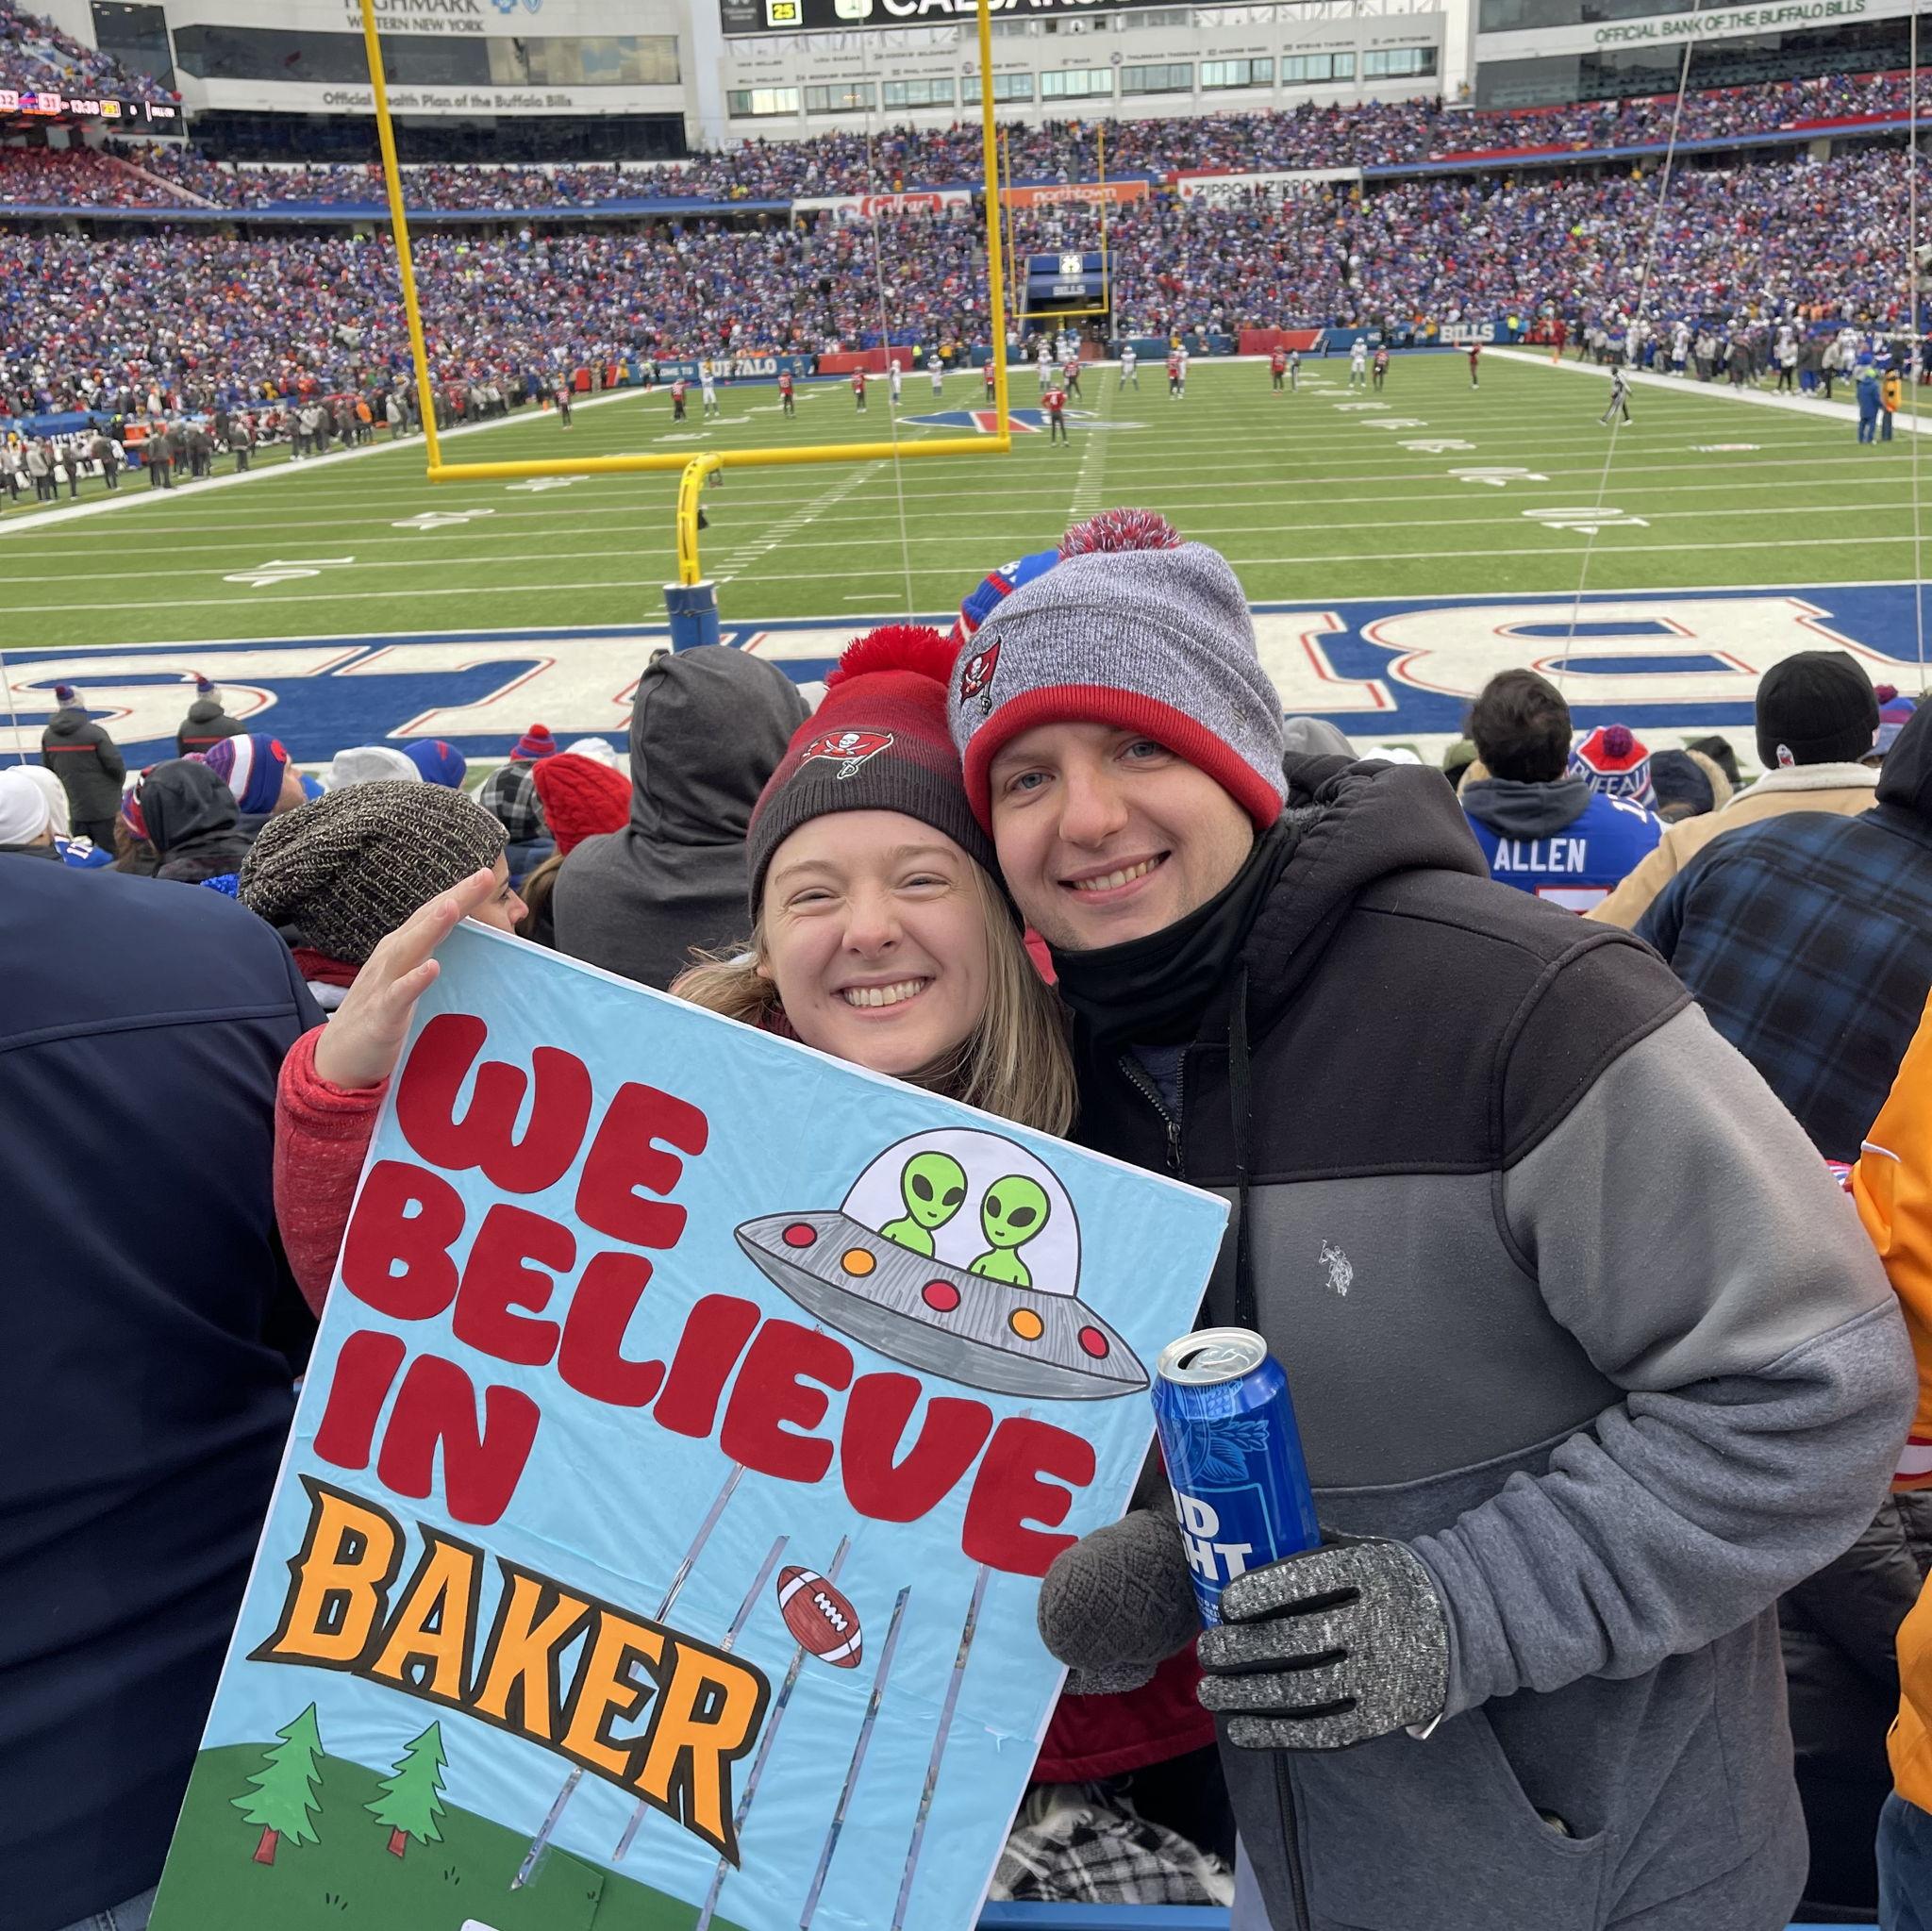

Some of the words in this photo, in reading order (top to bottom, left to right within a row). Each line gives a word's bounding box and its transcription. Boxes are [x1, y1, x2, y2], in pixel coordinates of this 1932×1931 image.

[344, 0, 481, 13] HGHMARK
[772, 3, 796, 21] 25
[347, 15, 408, 30] WTERN
[412, 18, 446, 31] NEW
[448, 19, 485, 32] YORK
[1594, 24, 1658, 43] OFFICIAL
[1662, 18, 1702, 36] BANK
[1705, 15, 1725, 31] OF
[1726, 11, 1757, 29] THE
[1759, 4, 1824, 25] BUFFALO
[1825, 0, 1866, 17] BILLS
[323, 92, 372, 106] Official
[377, 92, 419, 107] ealth
[421, 92, 452, 108] Plan
[454, 92, 469, 107] of
[471, 93, 491, 108] the
[495, 93, 543, 108] Buffalo
[547, 94, 573, 108] Bills
[1032, 186, 1118, 203] northtown
[1053, 285, 1086, 297] BILLS
[1439, 323, 1496, 342] BILLS
[1493, 838, 1587, 873] ALLEN
[394, 1013, 709, 1250] WE
[341, 1159, 1096, 1576] BELIEVE
[313, 1330, 541, 1526] IN
[246, 1473, 771, 1871] BAKER
